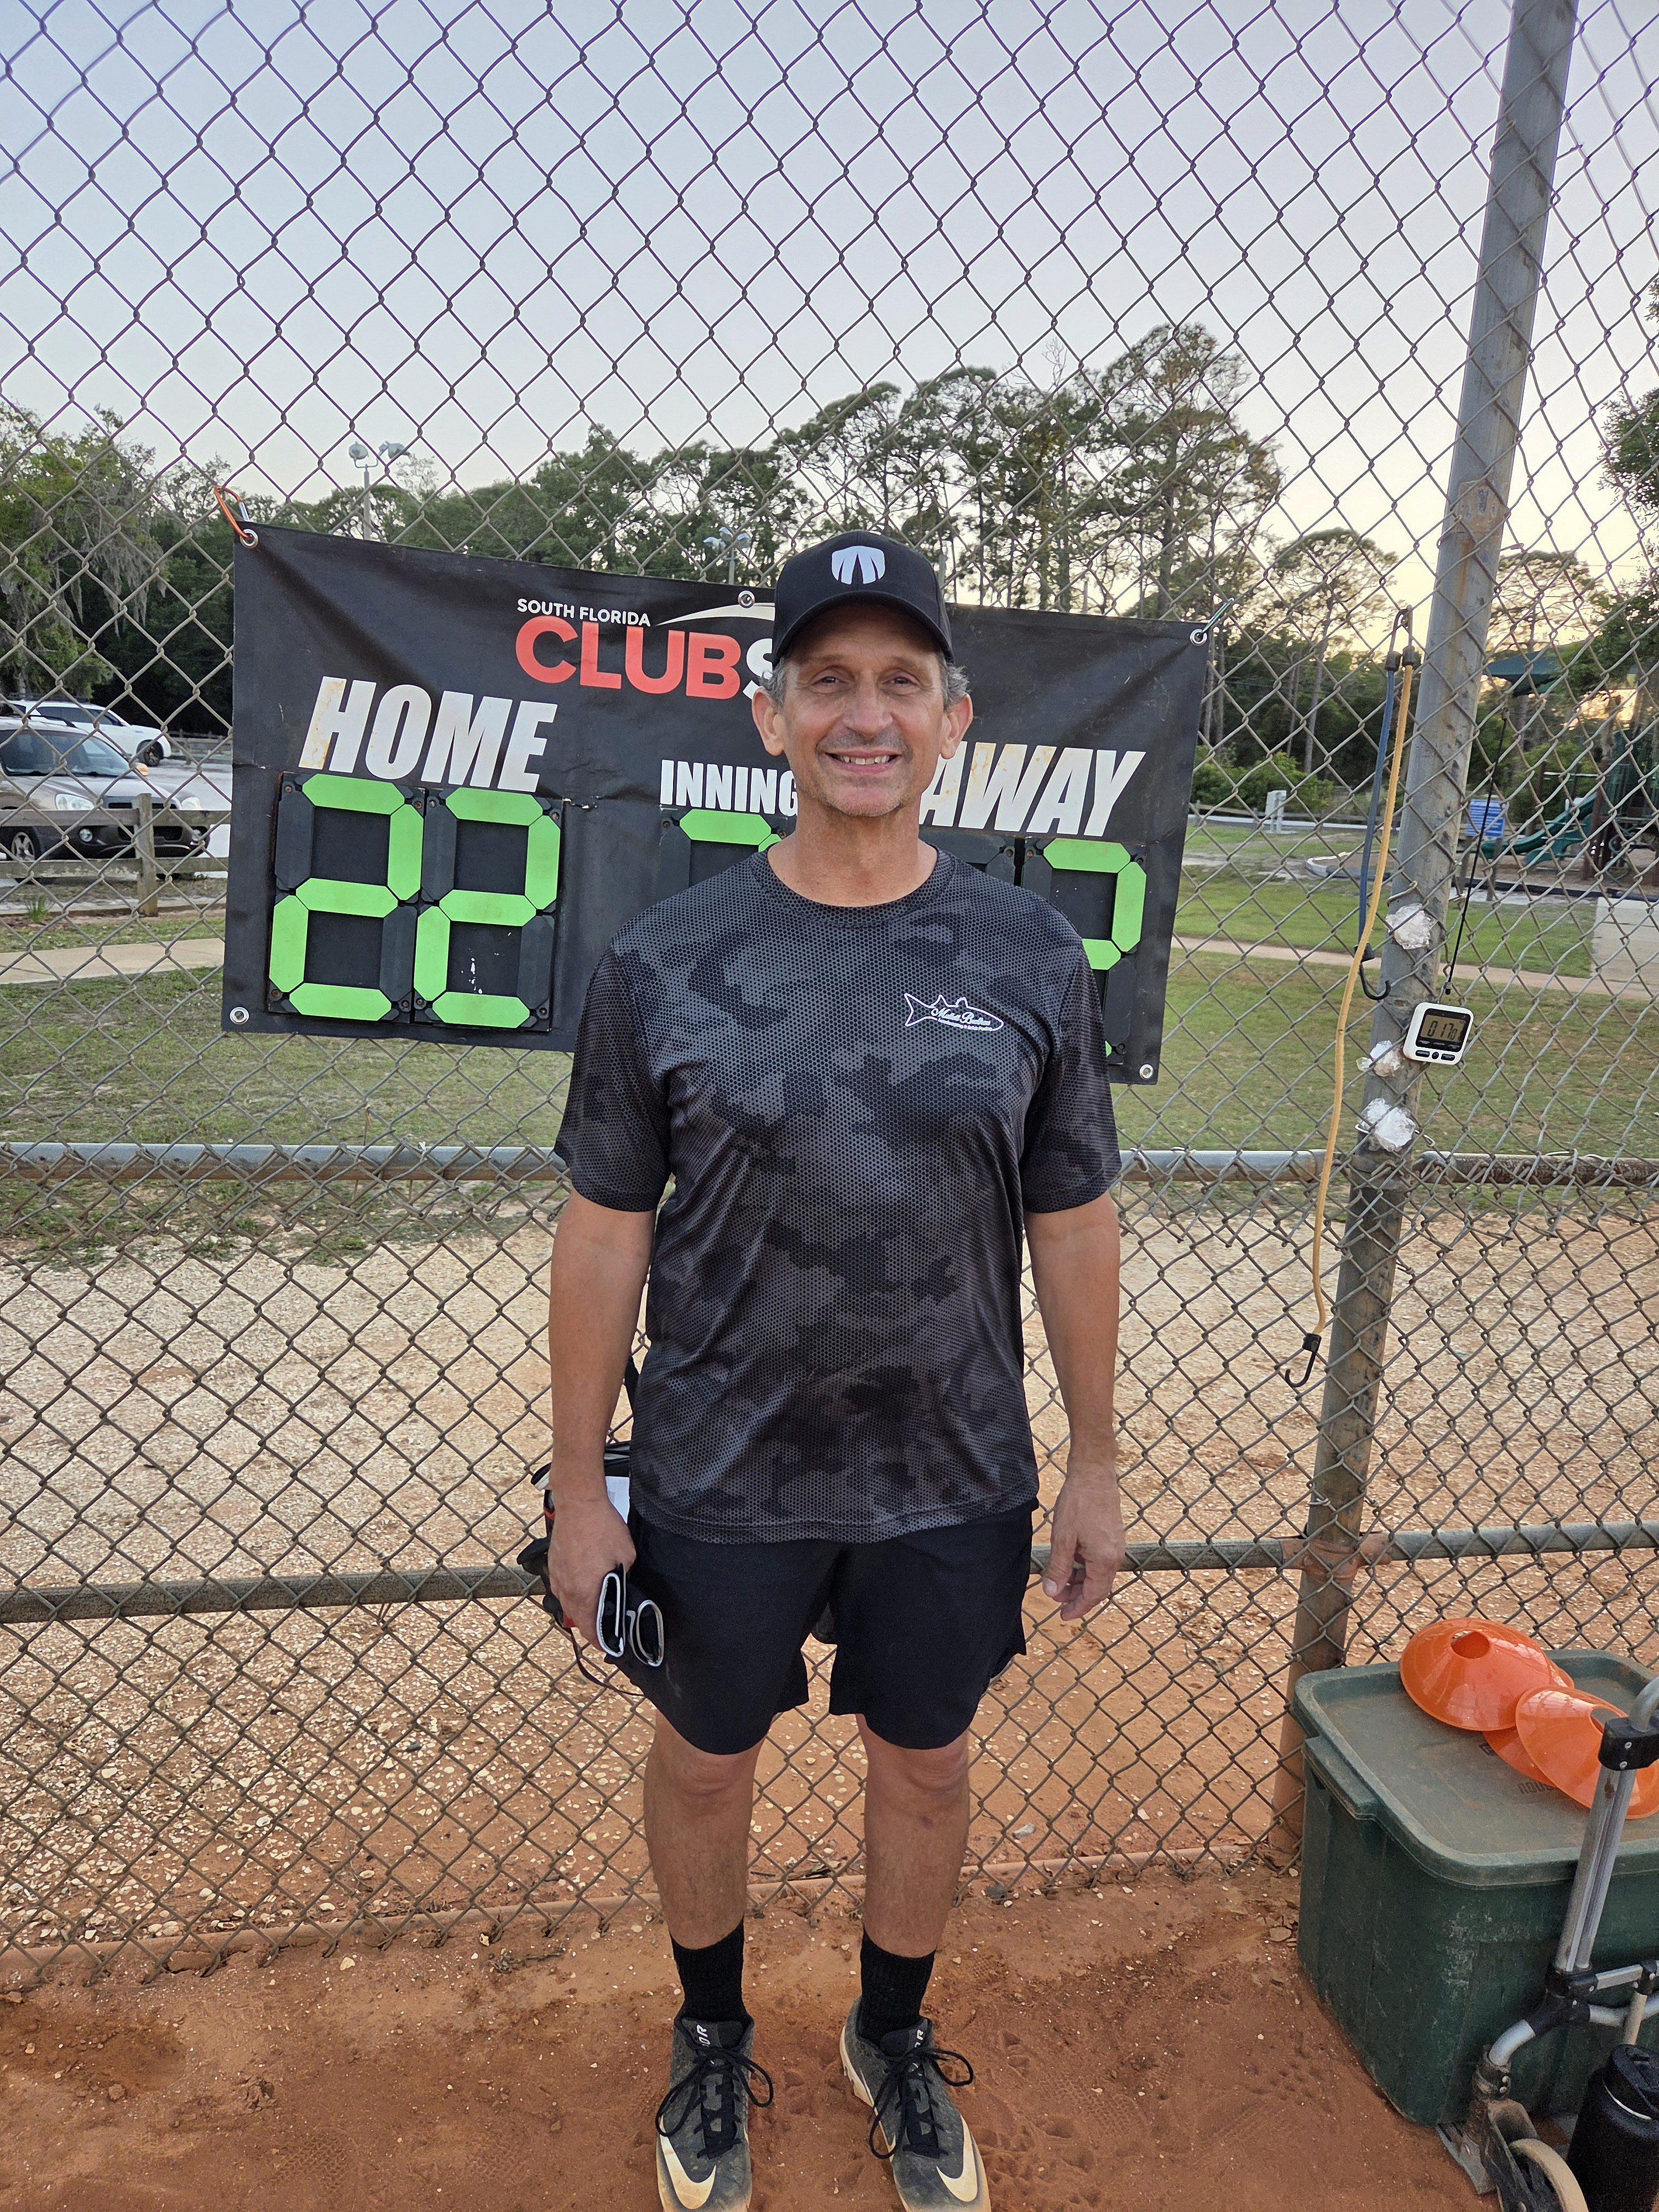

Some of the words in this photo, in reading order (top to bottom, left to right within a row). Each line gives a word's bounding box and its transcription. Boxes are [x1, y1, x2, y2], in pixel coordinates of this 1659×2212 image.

[517, 598, 575, 618] SOUTH
[580, 607, 651, 627] FLORIDA
[299, 676, 557, 792] HOME
[660, 759, 798, 817] INNING
[919, 741, 1146, 837] AWAY
[269, 774, 561, 1029] 22
